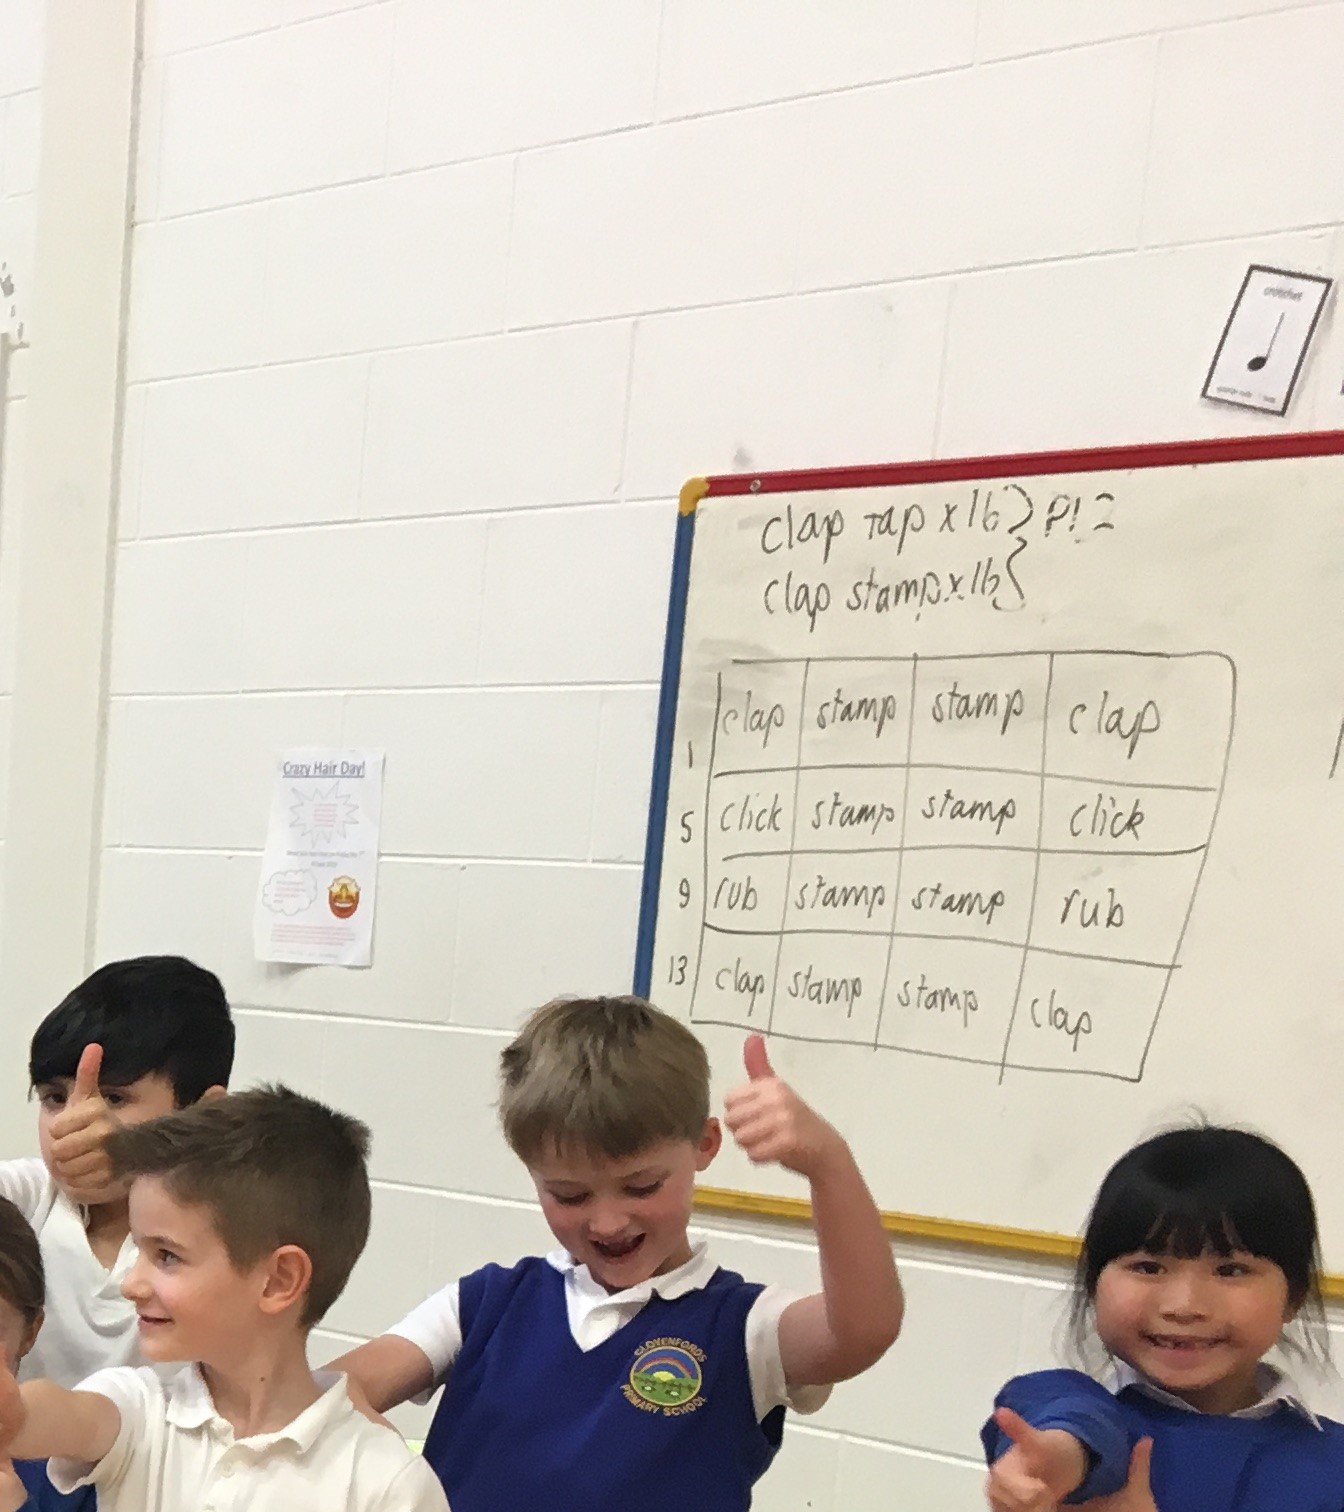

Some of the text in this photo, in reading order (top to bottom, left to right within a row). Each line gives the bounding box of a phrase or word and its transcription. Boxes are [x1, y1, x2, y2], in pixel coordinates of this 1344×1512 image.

[763, 571, 831, 633] clap
[722, 689, 785, 749] clap
[817, 687, 896, 738] stamp
[931, 681, 1024, 736] stamp
[1069, 690, 1161, 760] clap
[283, 760, 365, 777] Crazy Hair Day!
[720, 793, 783, 833] click
[811, 791, 895, 836] stamp
[922, 789, 1016, 836] stamp
[1070, 792, 1144, 841] click
[678, 874, 1125, 929] 9 rub stamp stamp rub
[668, 955, 1093, 1053] 13 clap stamp stamp clap
[663, 1396, 707, 1416] SCHOOL
